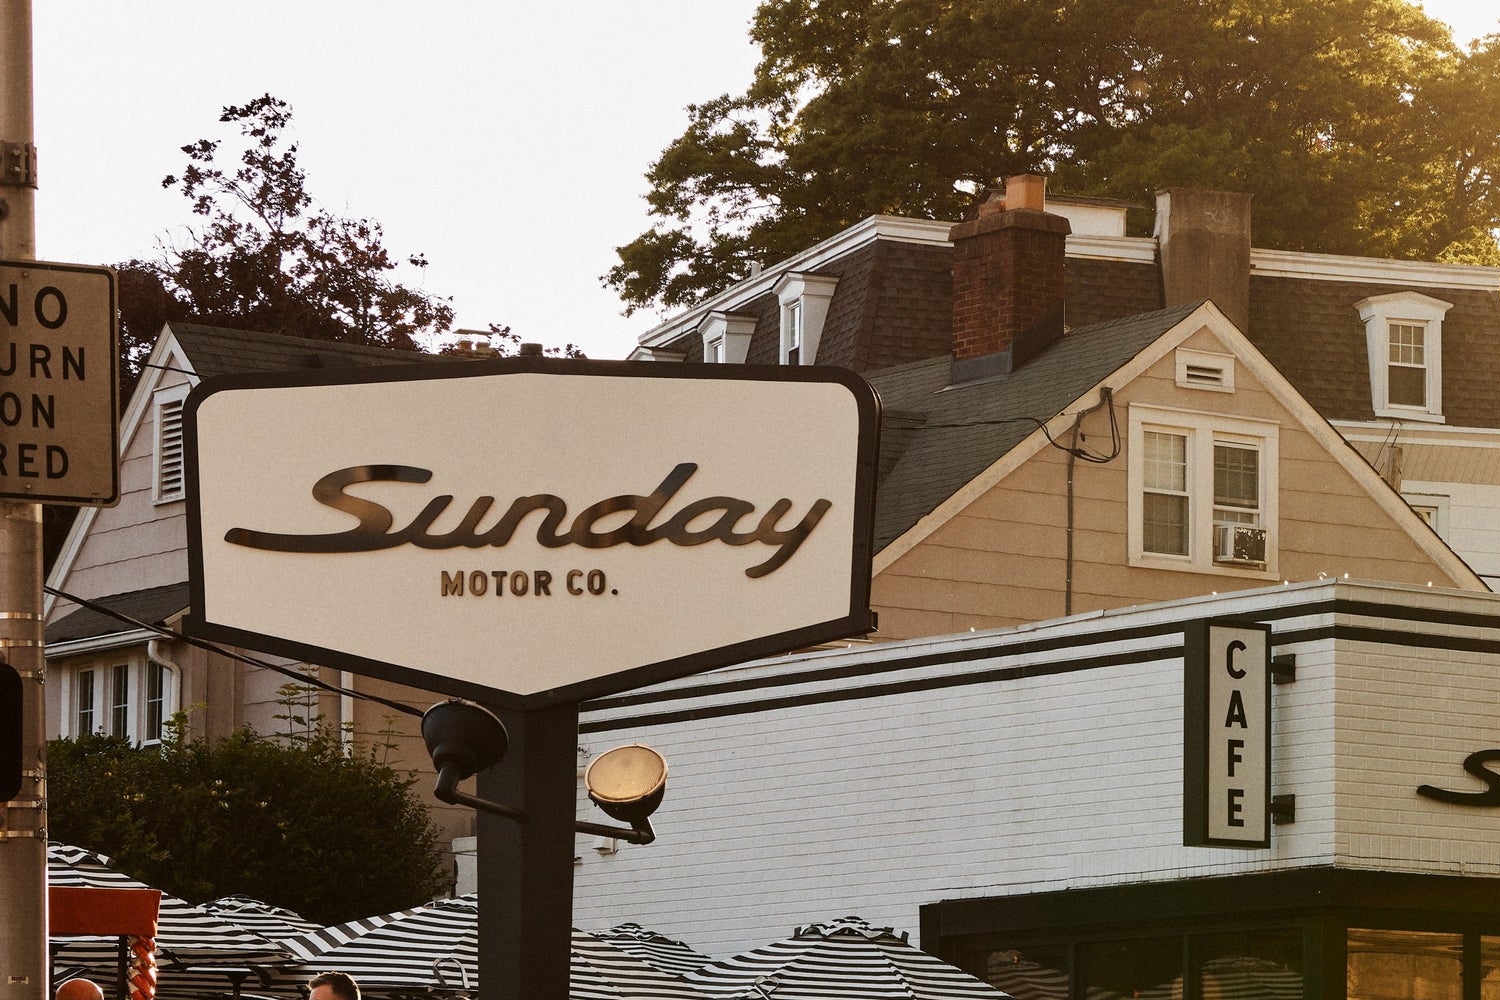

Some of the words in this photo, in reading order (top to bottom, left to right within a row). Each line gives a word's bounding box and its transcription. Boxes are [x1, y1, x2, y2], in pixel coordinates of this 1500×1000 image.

[0, 284, 68, 330] NO
[0, 343, 85, 381] URN
[0, 391, 55, 429] ON
[224, 462, 832, 578] Sunday
[441, 570, 552, 597] MOTOR
[566, 569, 619, 596] CO.
[1224, 639, 1248, 828] CAFE
